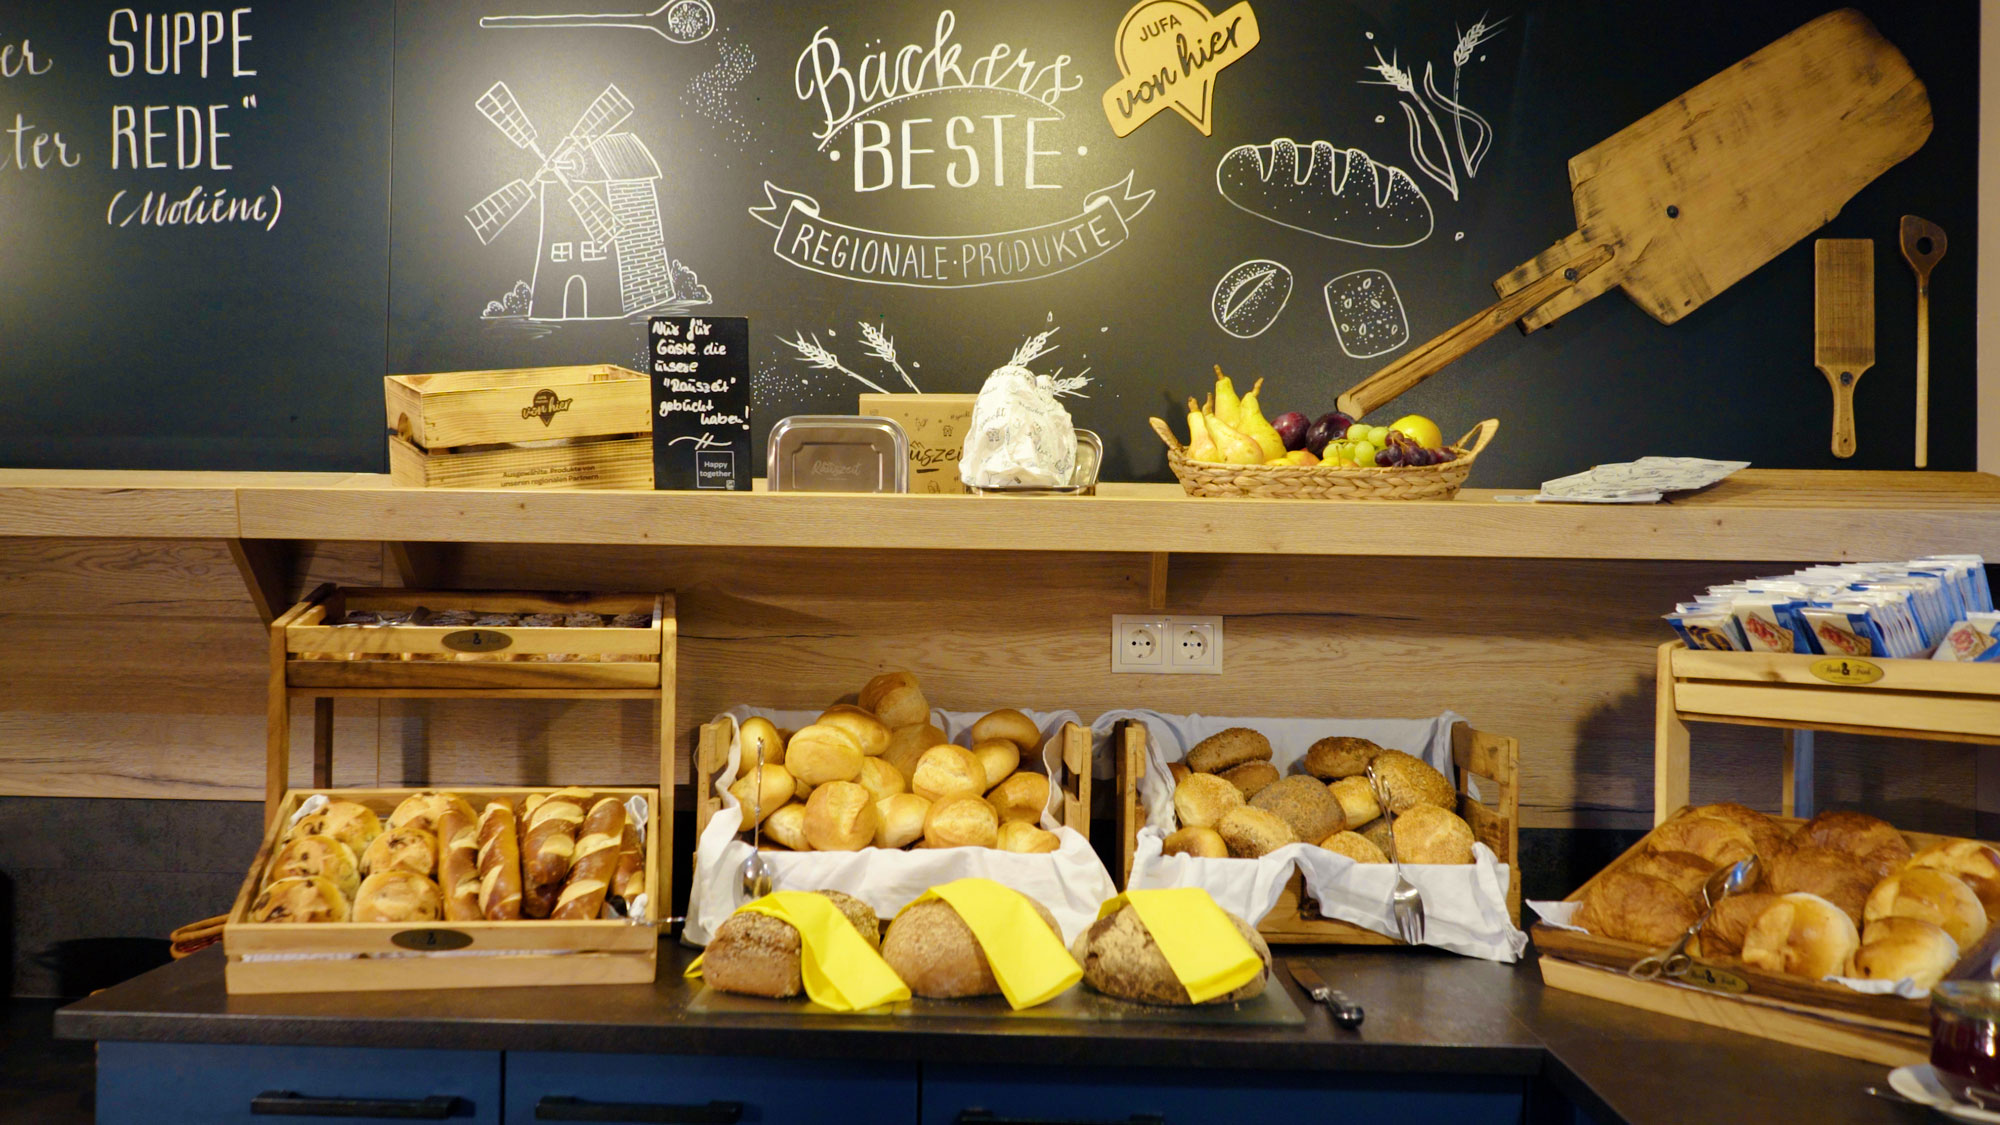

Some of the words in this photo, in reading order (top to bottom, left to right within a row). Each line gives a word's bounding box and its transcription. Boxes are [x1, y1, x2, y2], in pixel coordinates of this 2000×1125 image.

[1140, 14, 1182, 42] JUFA
[108, 8, 258, 78] SUPPE
[795, 10, 1083, 139] Bäckers
[1116, 66, 1177, 119] von
[1176, 16, 1242, 78] hier
[854, 113, 1063, 192] BESTE
[686, 317, 712, 341] für
[703, 342, 727, 355] die
[699, 470, 732, 479] together
[704, 461, 728, 469] Happy
